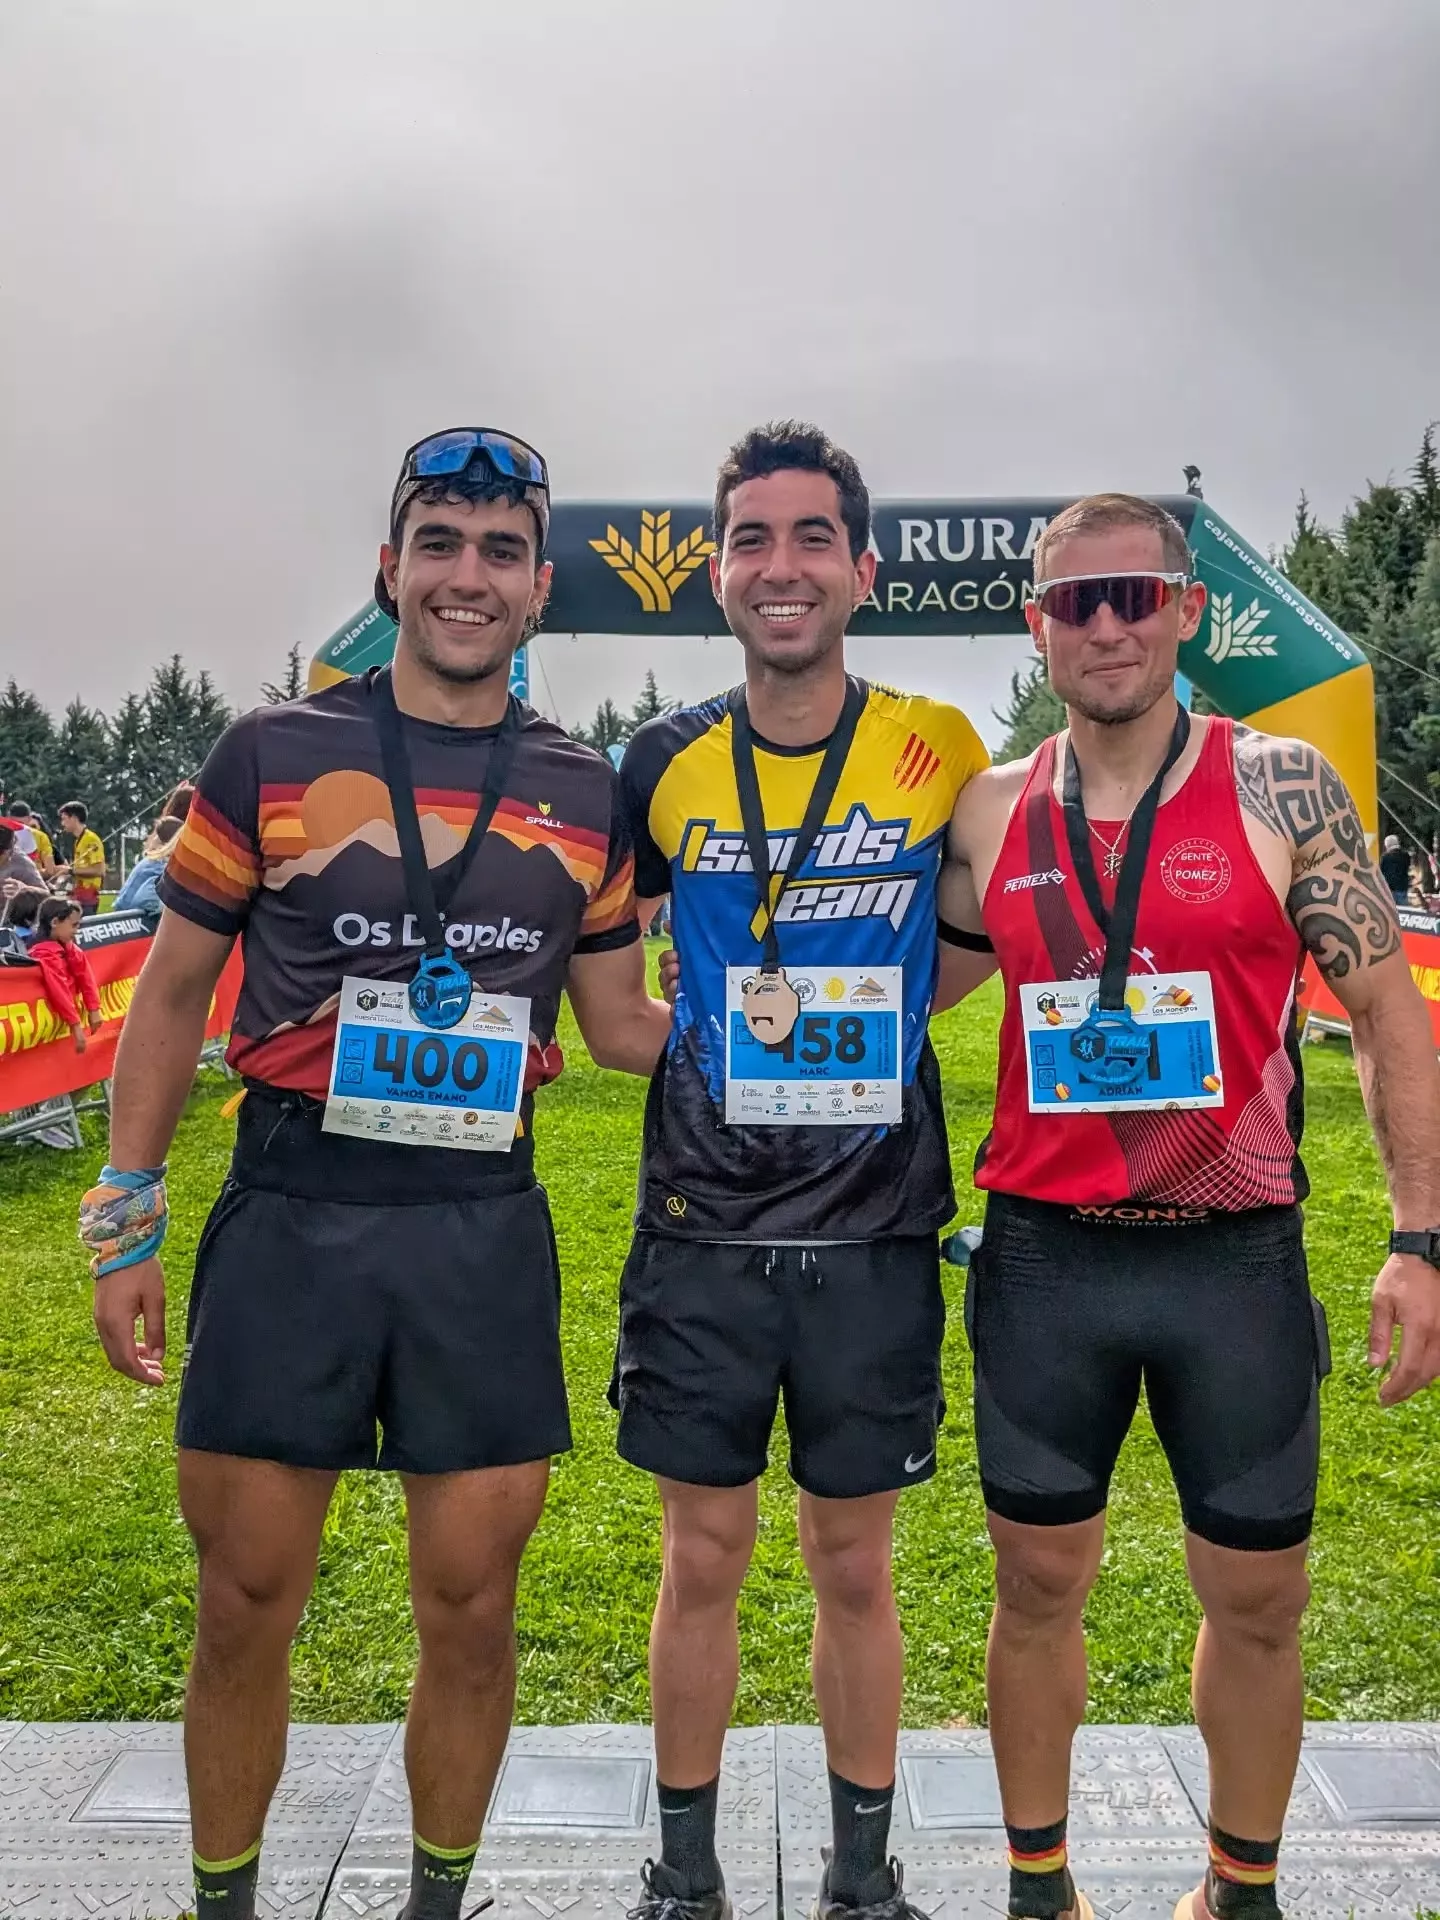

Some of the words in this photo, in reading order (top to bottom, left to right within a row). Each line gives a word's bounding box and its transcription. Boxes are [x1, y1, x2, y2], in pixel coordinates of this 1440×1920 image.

[1203, 518, 1353, 661] cajaruraldearagon.es
[524, 816, 564, 829] SPALL
[1180, 852, 1213, 862] GENTE
[1003, 872, 1049, 894] PENTEX
[75, 917, 150, 945] FIREHAWK
[333, 912, 392, 946] Os
[402, 911, 544, 953] Daples
[1107, 1034, 1150, 1047] TRAIL
[373, 1032, 489, 1092] 400
[799, 1067, 831, 1076] MARC
[385, 1087, 425, 1098] VAMOS
[427, 1091, 467, 1103] ENANO
[1098, 1086, 1144, 1096] ADRIAN
[1074, 1205, 1209, 1220] WONG
